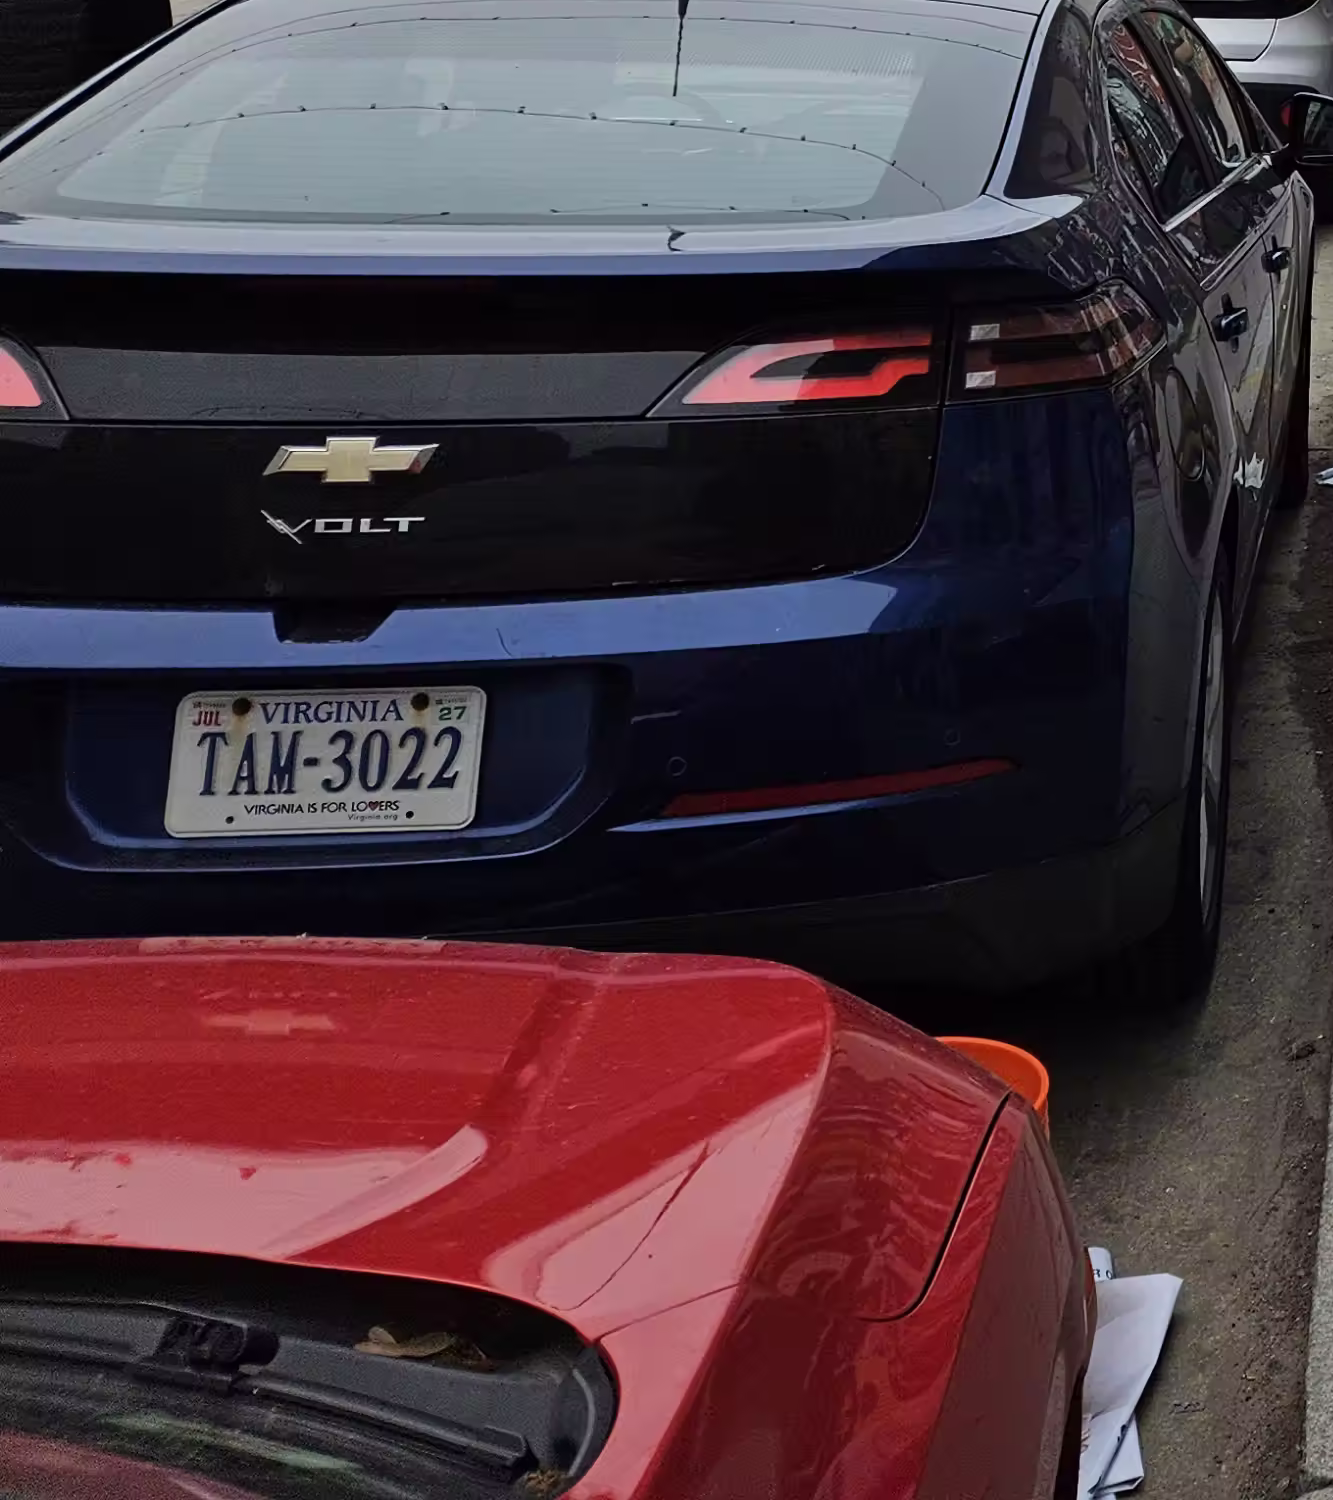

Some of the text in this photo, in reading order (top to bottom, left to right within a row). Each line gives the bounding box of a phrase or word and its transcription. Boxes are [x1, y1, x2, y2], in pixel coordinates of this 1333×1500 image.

[260, 509, 426, 545] VOLT
[193, 710, 222, 727] JUL
[259, 699, 405, 724] VIRGINIA
[438, 706, 468, 722] 27
[197, 726, 463, 797] TAM-3022
[244, 803, 304, 816] VIRGINIA
[307, 803, 318, 814] IS
[321, 802, 347, 813] FOR
